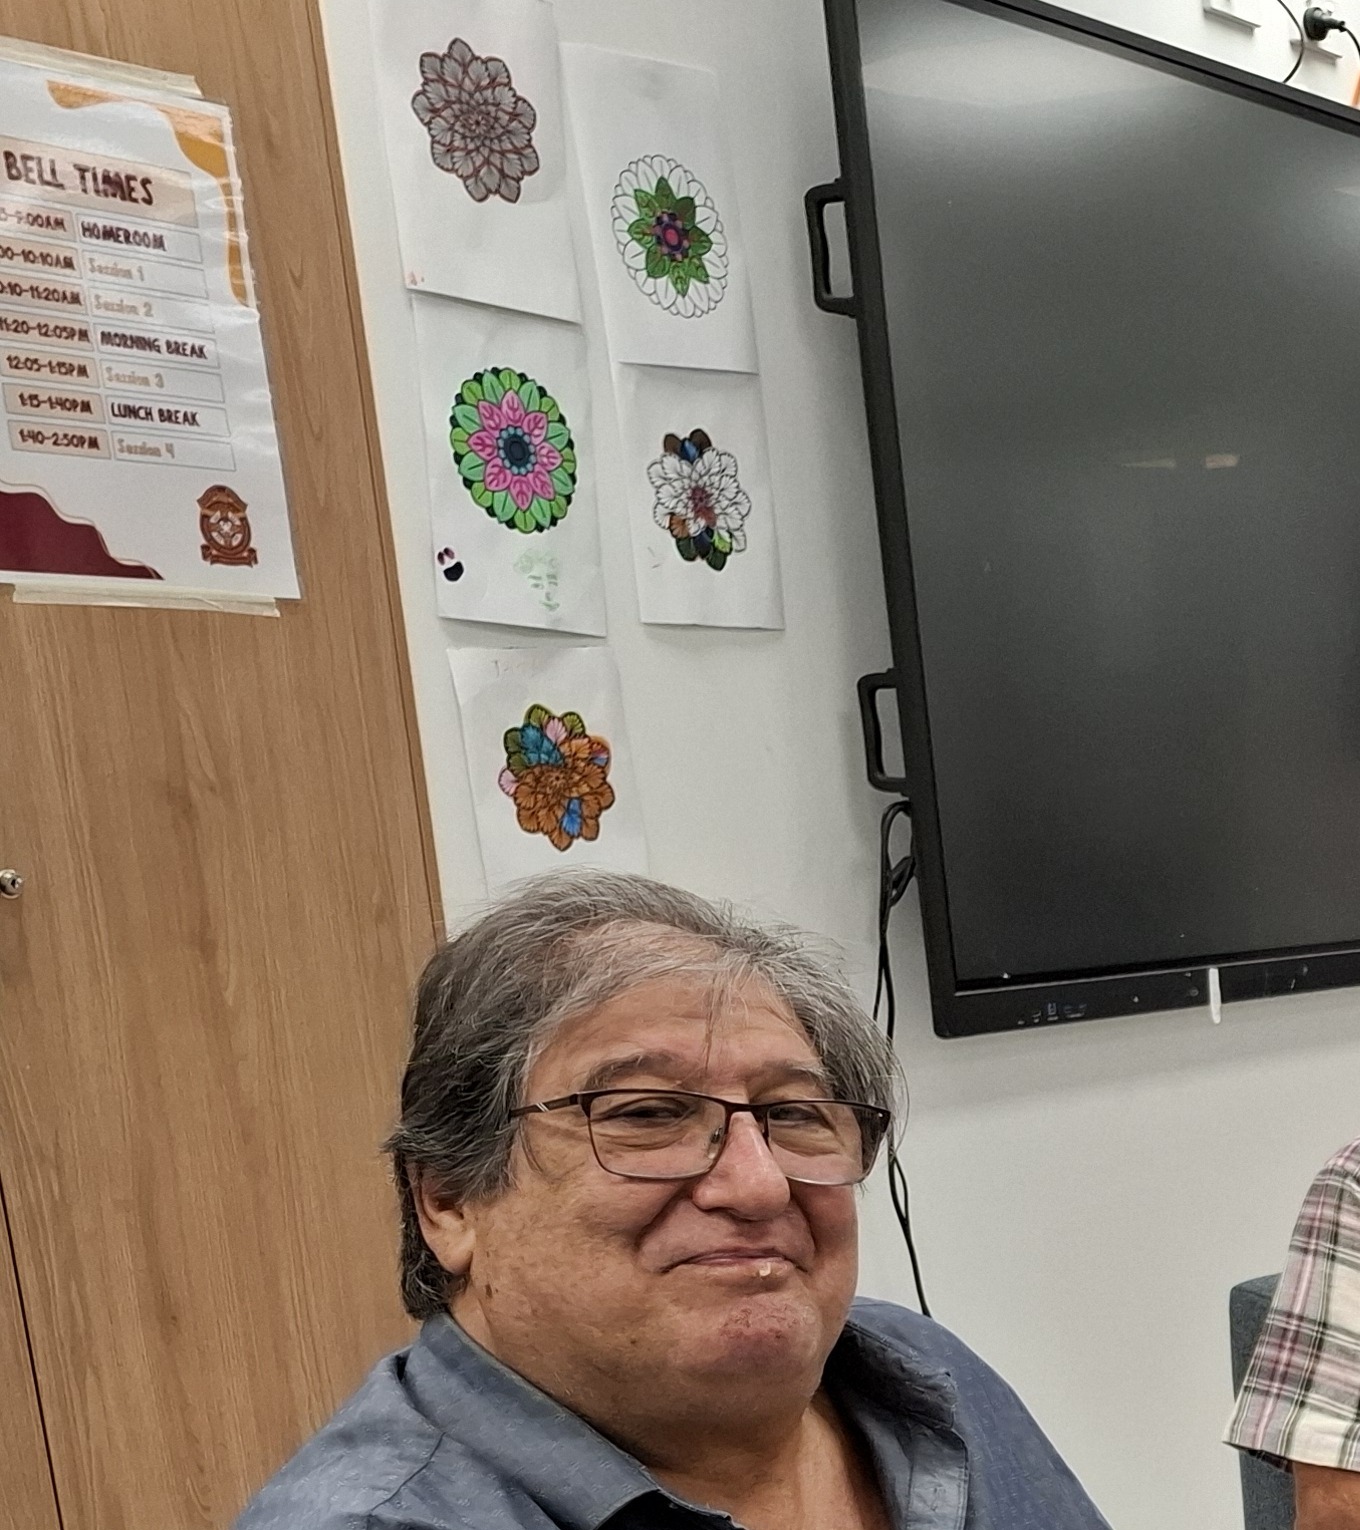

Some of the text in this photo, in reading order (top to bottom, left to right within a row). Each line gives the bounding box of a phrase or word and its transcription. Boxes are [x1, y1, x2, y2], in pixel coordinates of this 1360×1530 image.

[3, 150, 154, 206] BELL TIMES
[81, 220, 166, 251] HOMEROOM
[89, 257, 145, 282] Session 1
[94, 293, 154, 318] Session 2
[100, 330, 208, 359] MORNING BREAK
[105, 366, 165, 389] Session 3
[111, 401, 201, 427] LUNCH BREAK
[117, 438, 175, 459] Session 4
